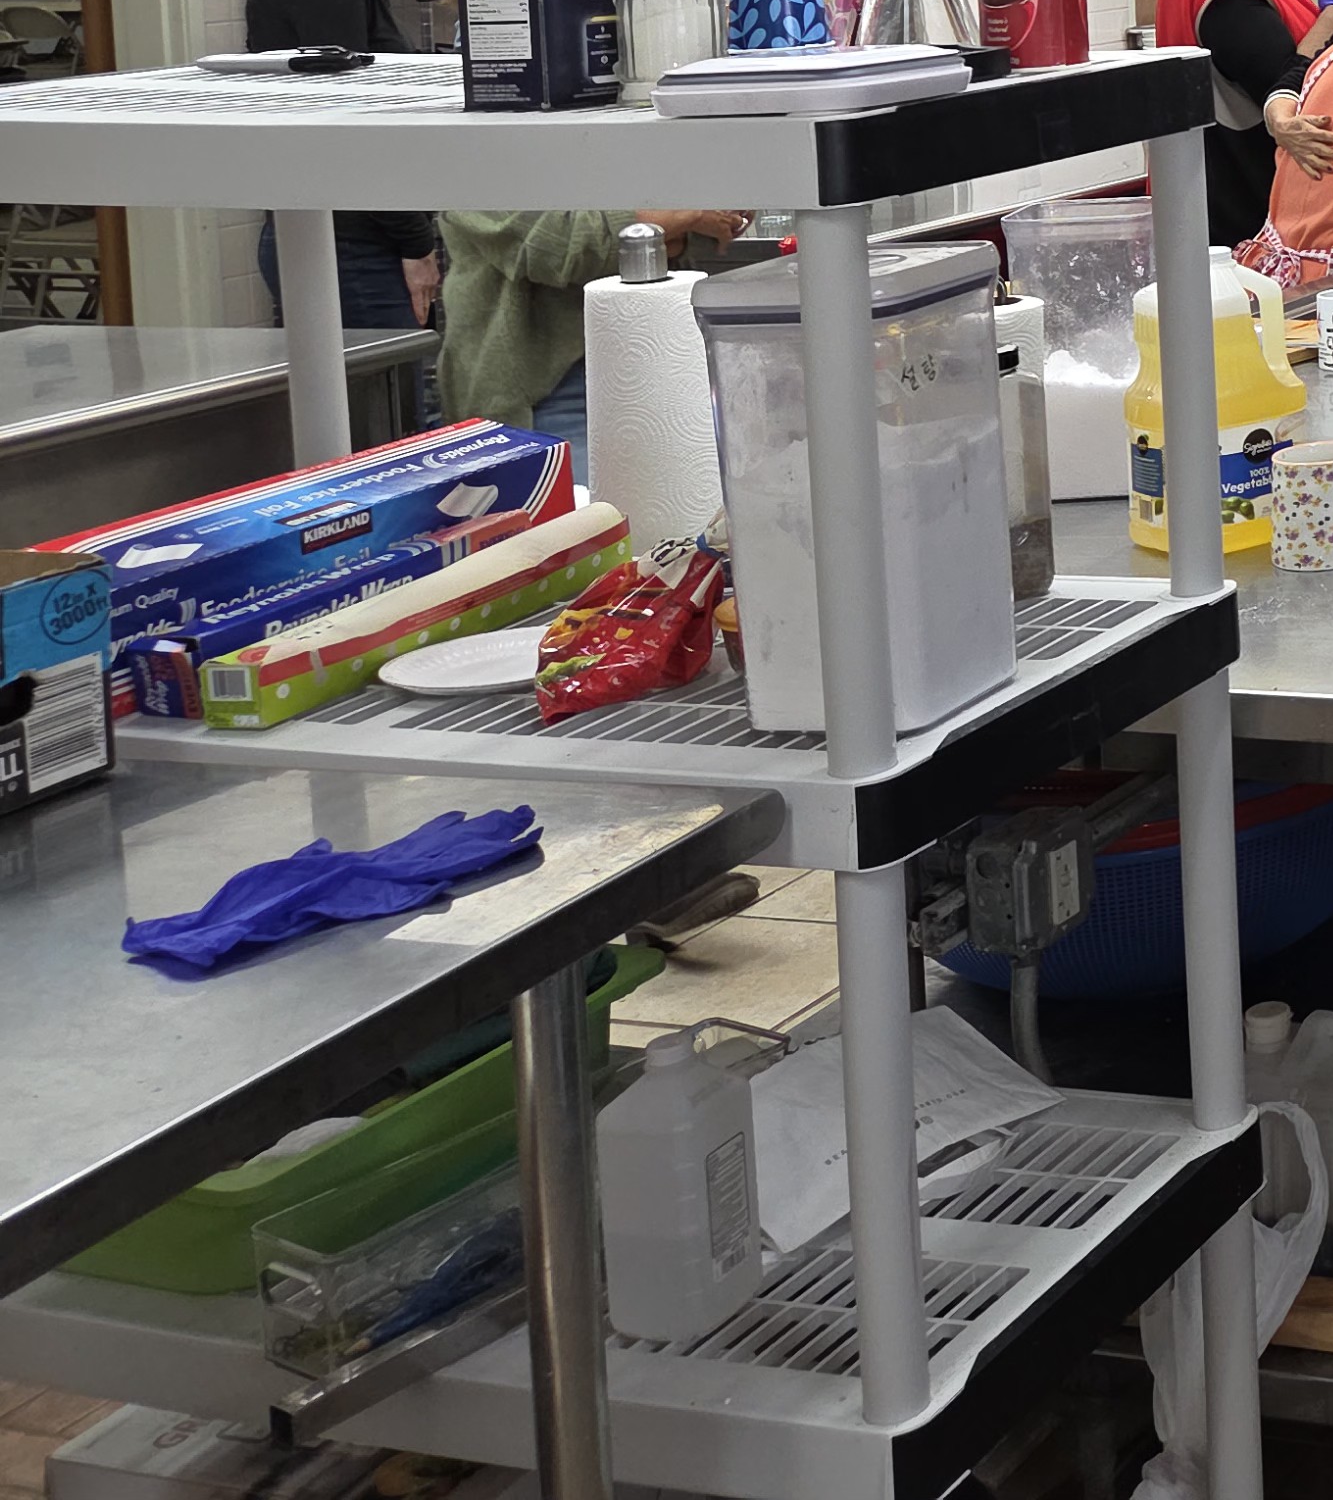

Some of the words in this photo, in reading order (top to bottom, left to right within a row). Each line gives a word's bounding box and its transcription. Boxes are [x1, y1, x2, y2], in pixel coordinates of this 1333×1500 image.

[901, 354, 936, 391] 설탕
[438, 434, 511, 460] Reynolds
[298, 464, 424, 502] Foodservice
[1250, 467, 1270, 477] 100%
[253, 501, 303, 517] Foil
[303, 512, 370, 544] KIRKLAND
[135, 587, 179, 608] Quality
